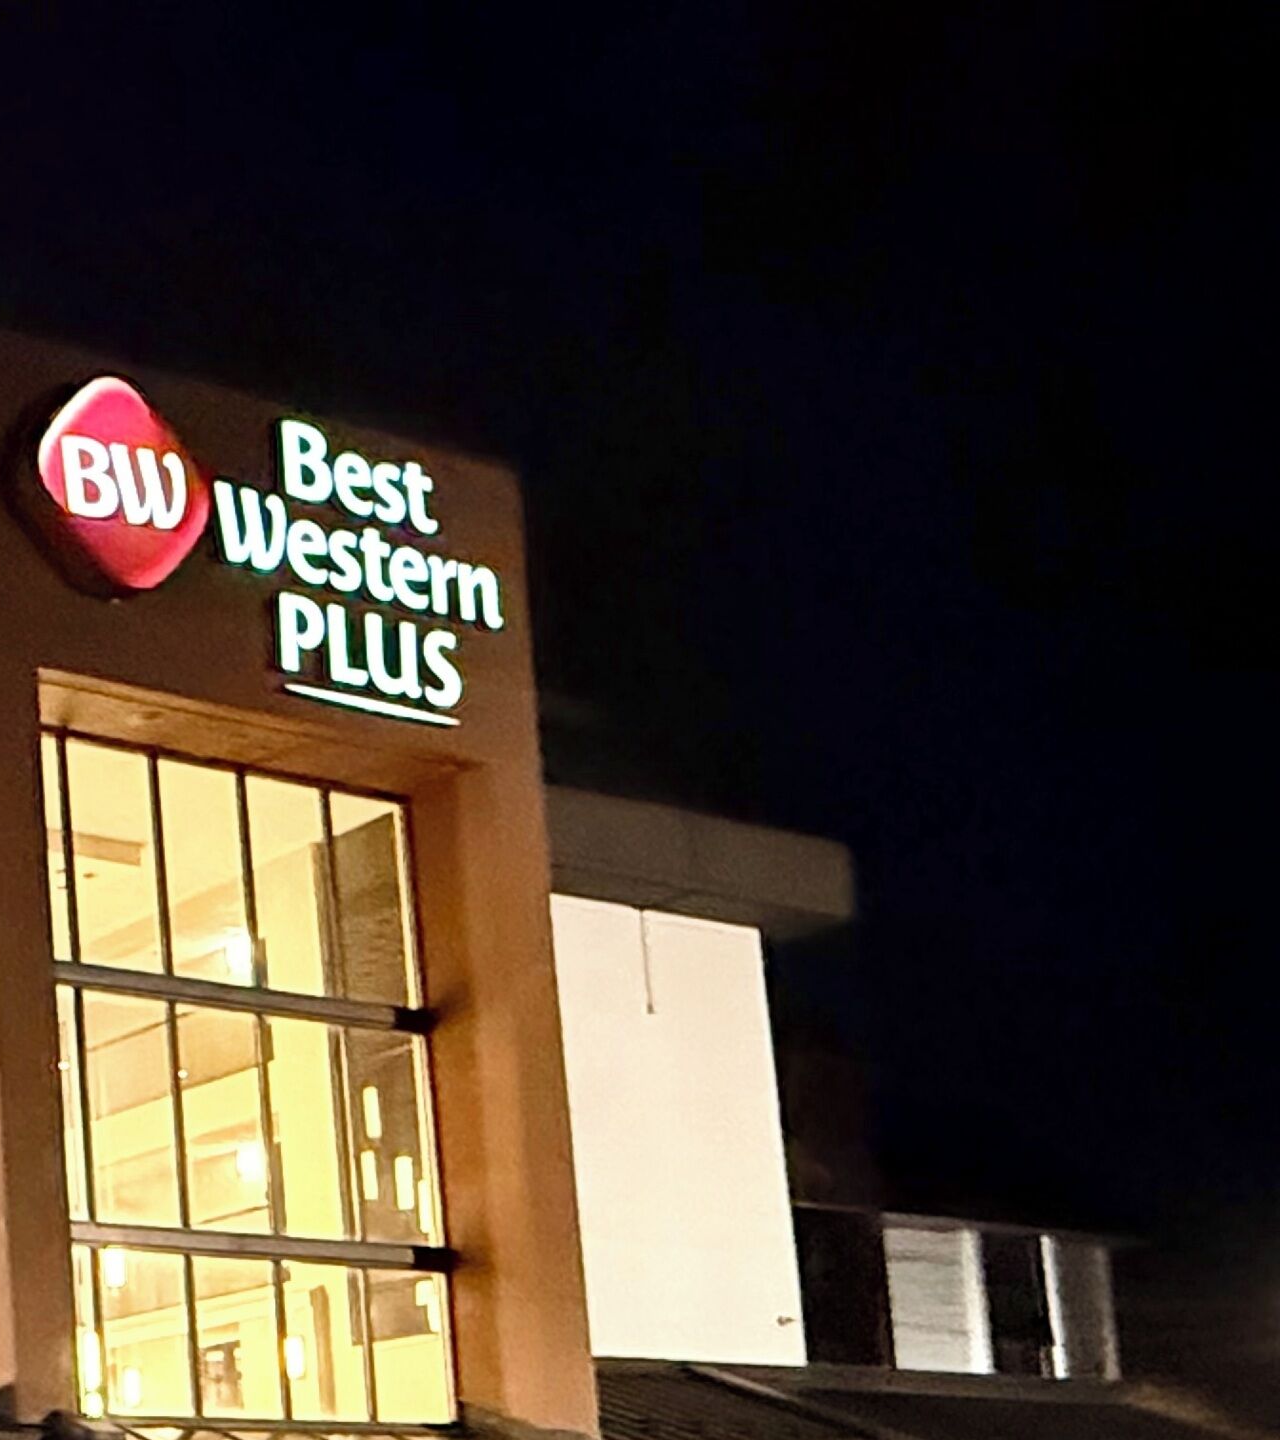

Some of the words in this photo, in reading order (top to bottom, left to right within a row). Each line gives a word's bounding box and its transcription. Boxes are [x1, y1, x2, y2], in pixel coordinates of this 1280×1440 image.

[60, 435, 187, 531] BW
[278, 418, 439, 535] Best
[214, 479, 504, 630] Western
[277, 592, 463, 710] PLUS
